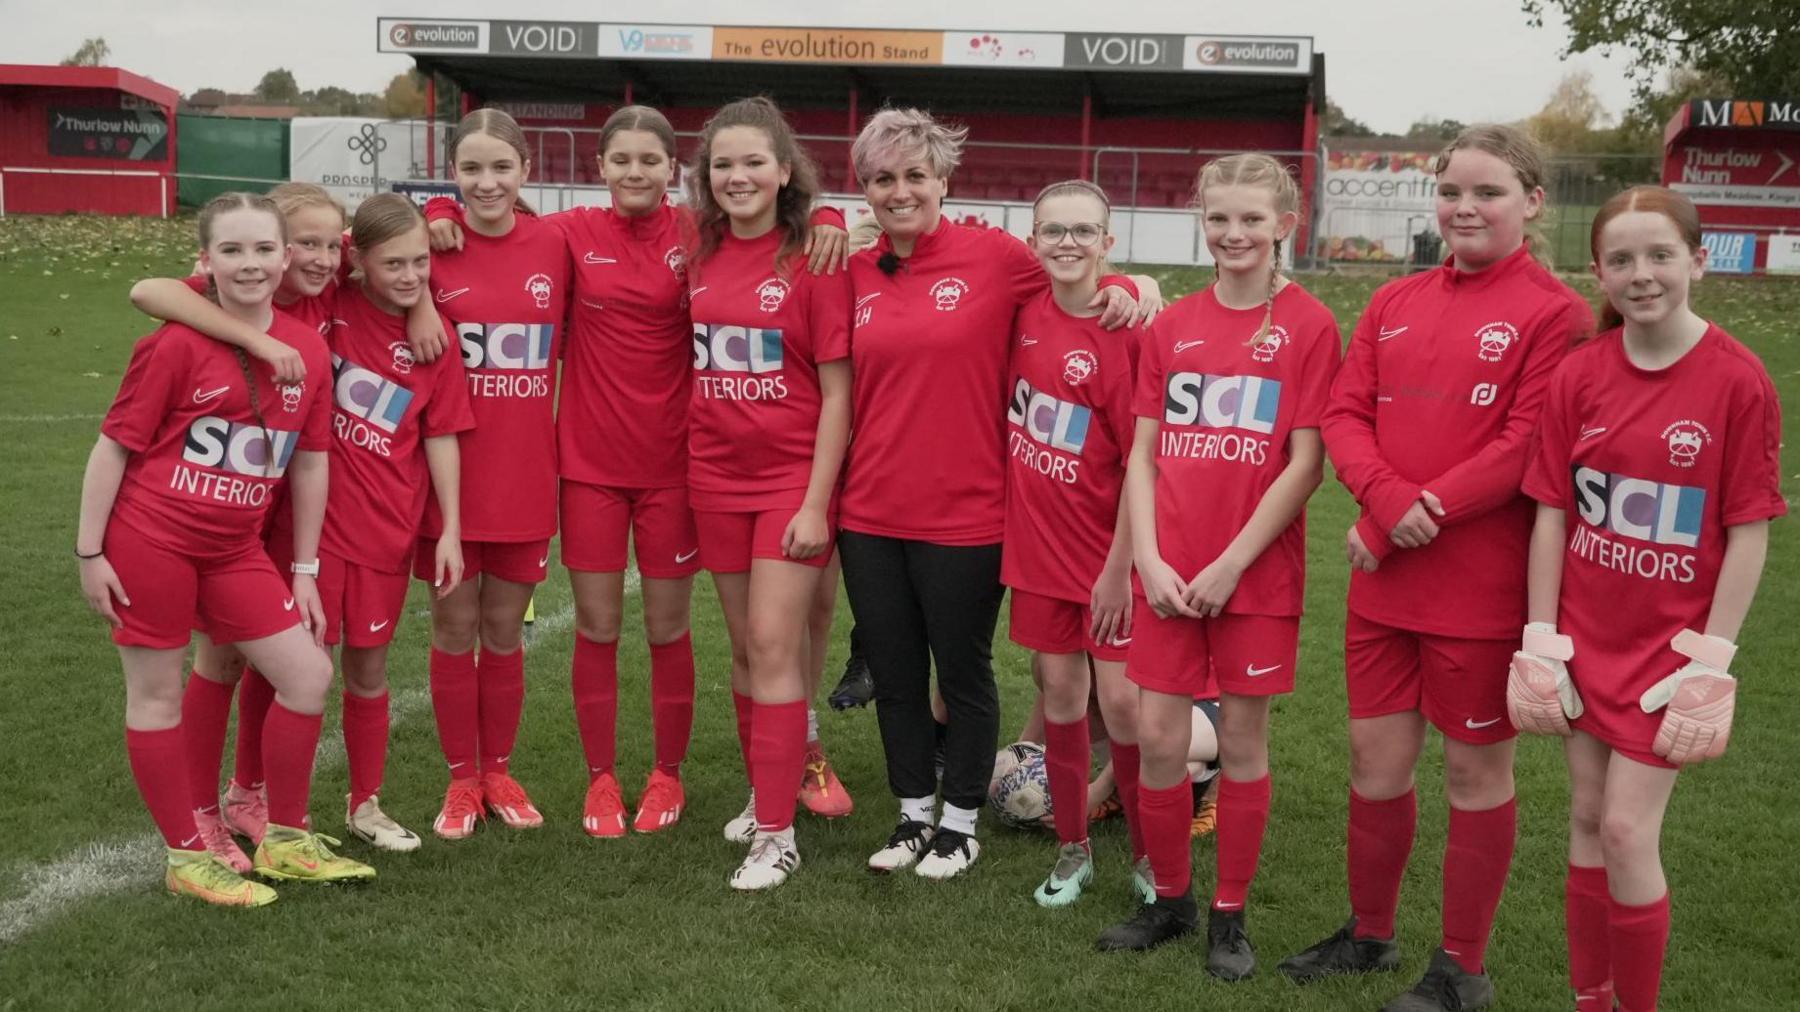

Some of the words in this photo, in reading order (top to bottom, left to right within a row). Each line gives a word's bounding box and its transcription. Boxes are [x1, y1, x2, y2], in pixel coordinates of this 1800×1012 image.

[415, 26, 476, 42] evolution
[506, 25, 577, 51] VOID
[725, 42, 752, 55] The
[761, 33, 875, 59] evolution
[882, 46, 929, 60] Stand
[1082, 37, 1160, 64] VOID
[1225, 43, 1295, 61] evolution
[65, 117, 122, 133] Thurlow
[123, 120, 160, 134] Nunn
[1685, 147, 1763, 168] Thurlow
[1682, 165, 1732, 184] Nunn
[457, 322, 549, 370] SCL
[692, 322, 783, 374] SCL
[1007, 377, 1084, 457] SCL
[1166, 371, 1273, 435] SCL
[183, 415, 289, 479] SCL
[1161, 431, 1270, 466] INTERIORS
[1575, 466, 1698, 548] SCL
[1570, 523, 1697, 584] INTERIORS
